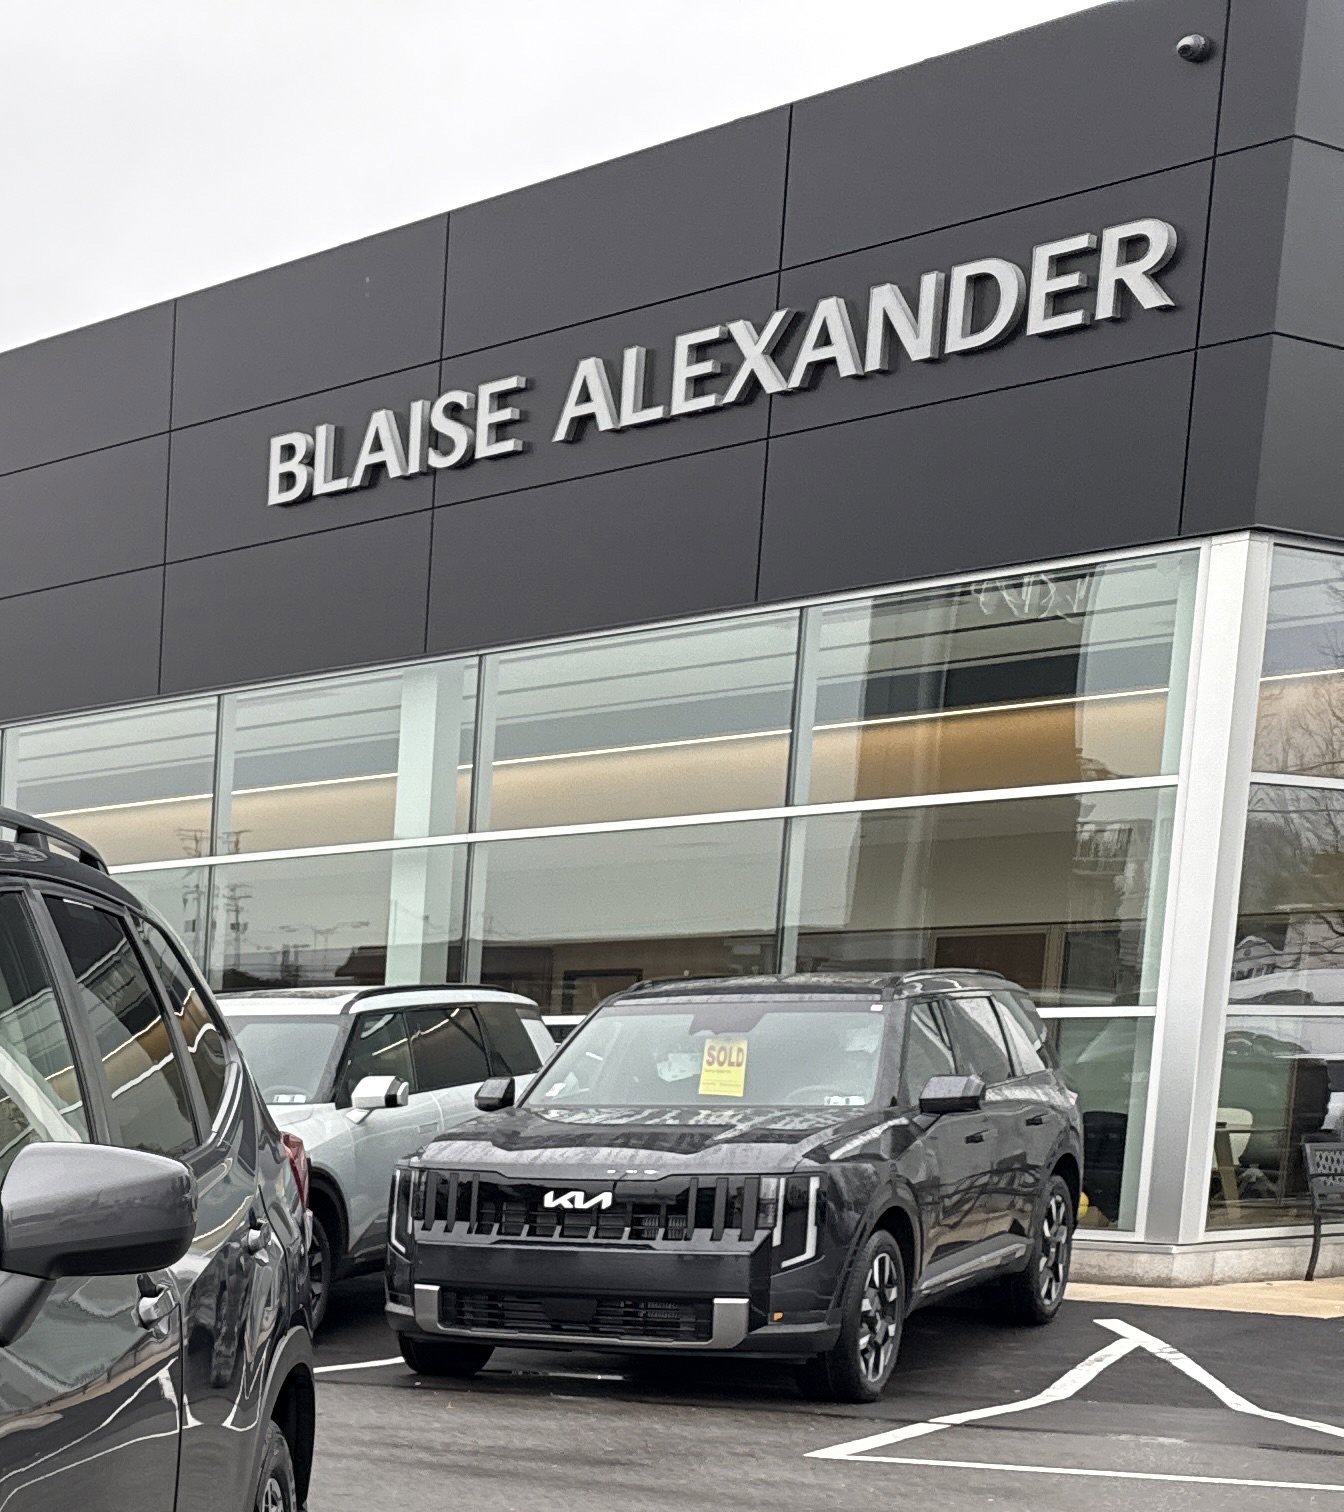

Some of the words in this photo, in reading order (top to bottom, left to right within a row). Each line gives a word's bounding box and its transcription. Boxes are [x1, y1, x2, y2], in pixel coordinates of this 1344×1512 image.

[267, 374, 528, 507] BLAISE
[552, 218, 1178, 444] ALEXANDER
[705, 1045, 745, 1068] SOLD
[543, 1190, 613, 1210] KIA
